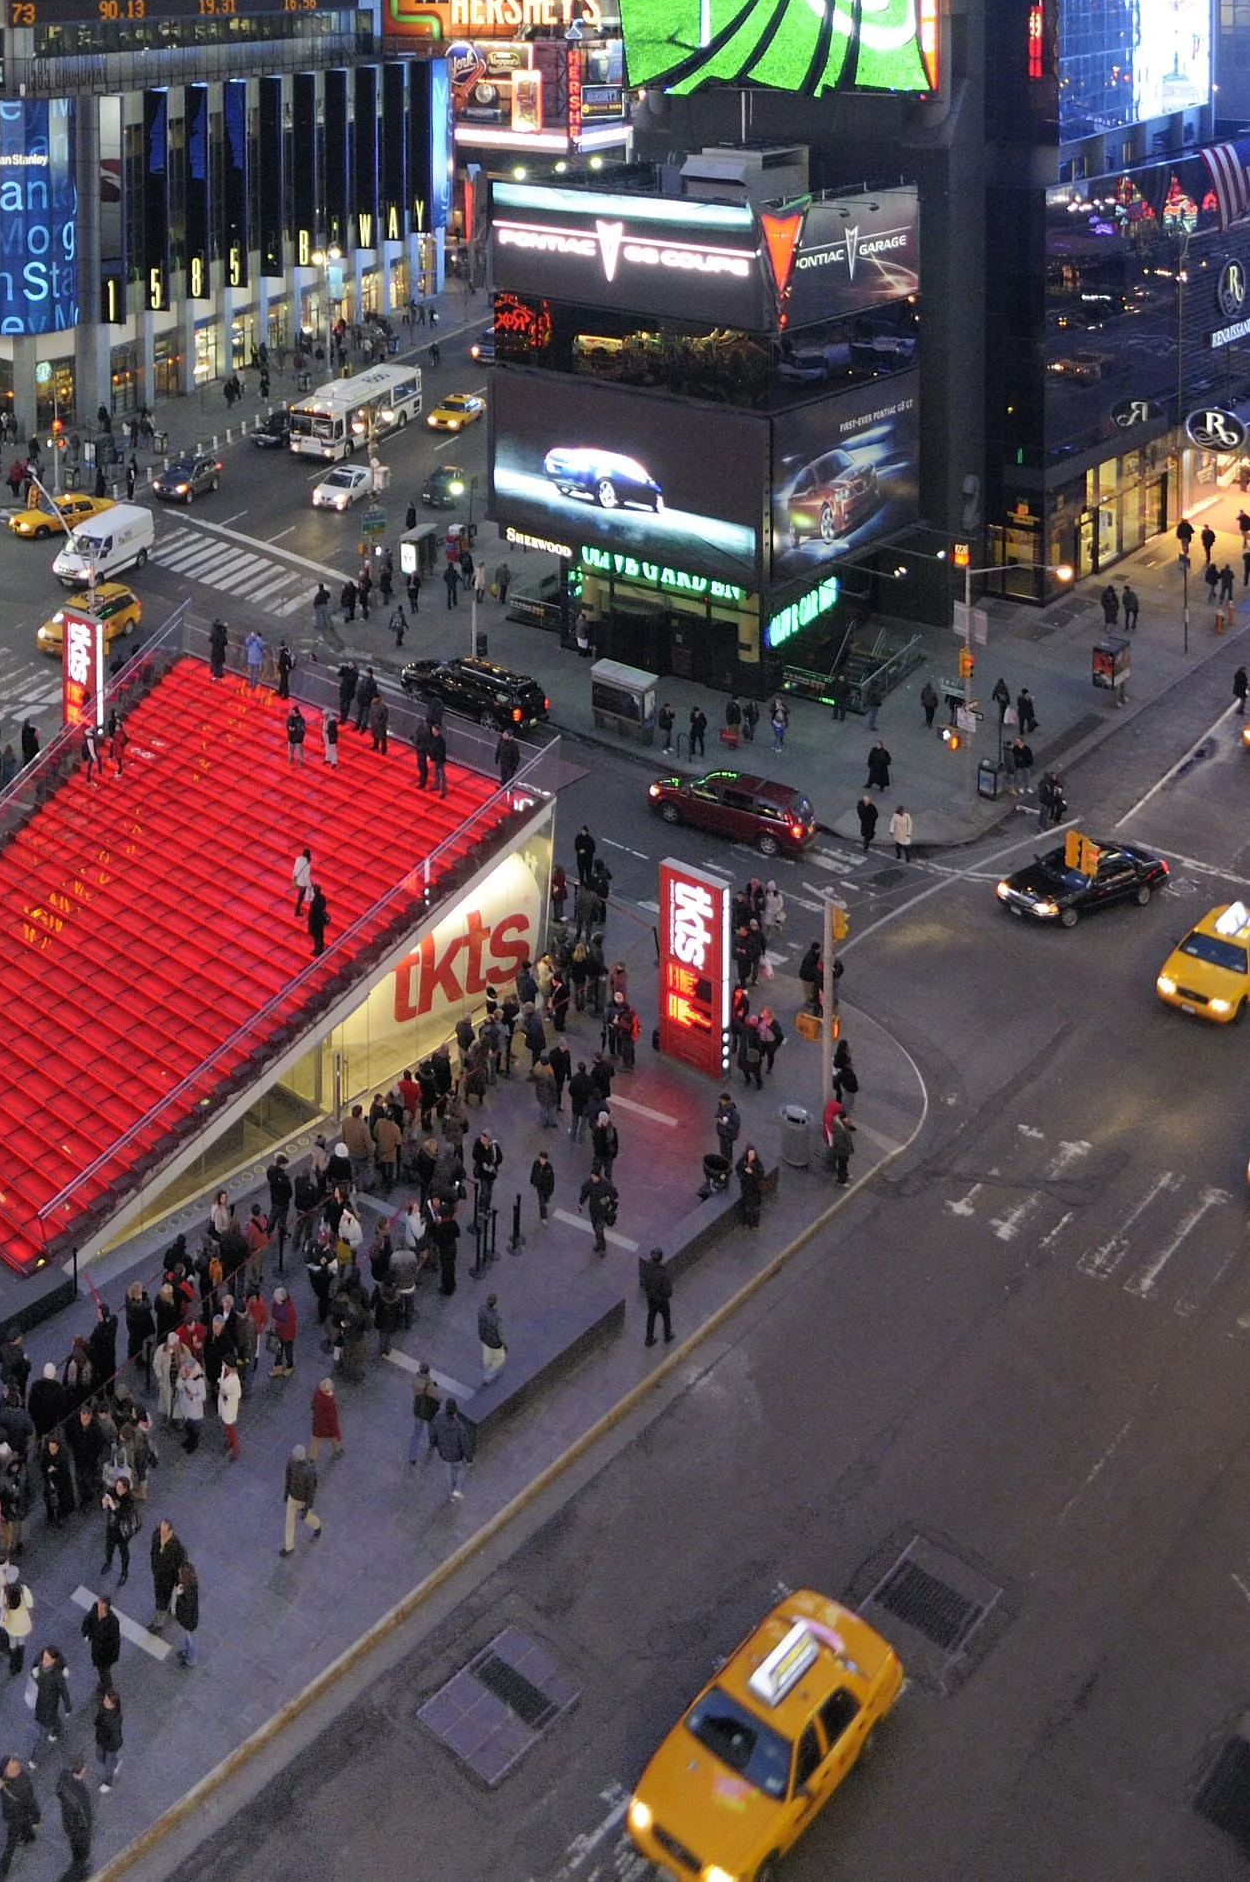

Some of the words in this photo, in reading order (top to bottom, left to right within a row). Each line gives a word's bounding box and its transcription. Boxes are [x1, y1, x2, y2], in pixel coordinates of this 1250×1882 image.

[11, 3, 36, 24] 73
[99, 0, 145, 20] 90.13
[12, 153, 49, 166] Stanley
[859, 235, 907, 256] GARAGE
[873, 405, 897, 420] PONTIAC
[506, 526, 573, 557] SHERWOOD
[70, 622, 92, 686] tkts
[674, 881, 714, 968] tkts
[393, 909, 531, 1023] tkts
